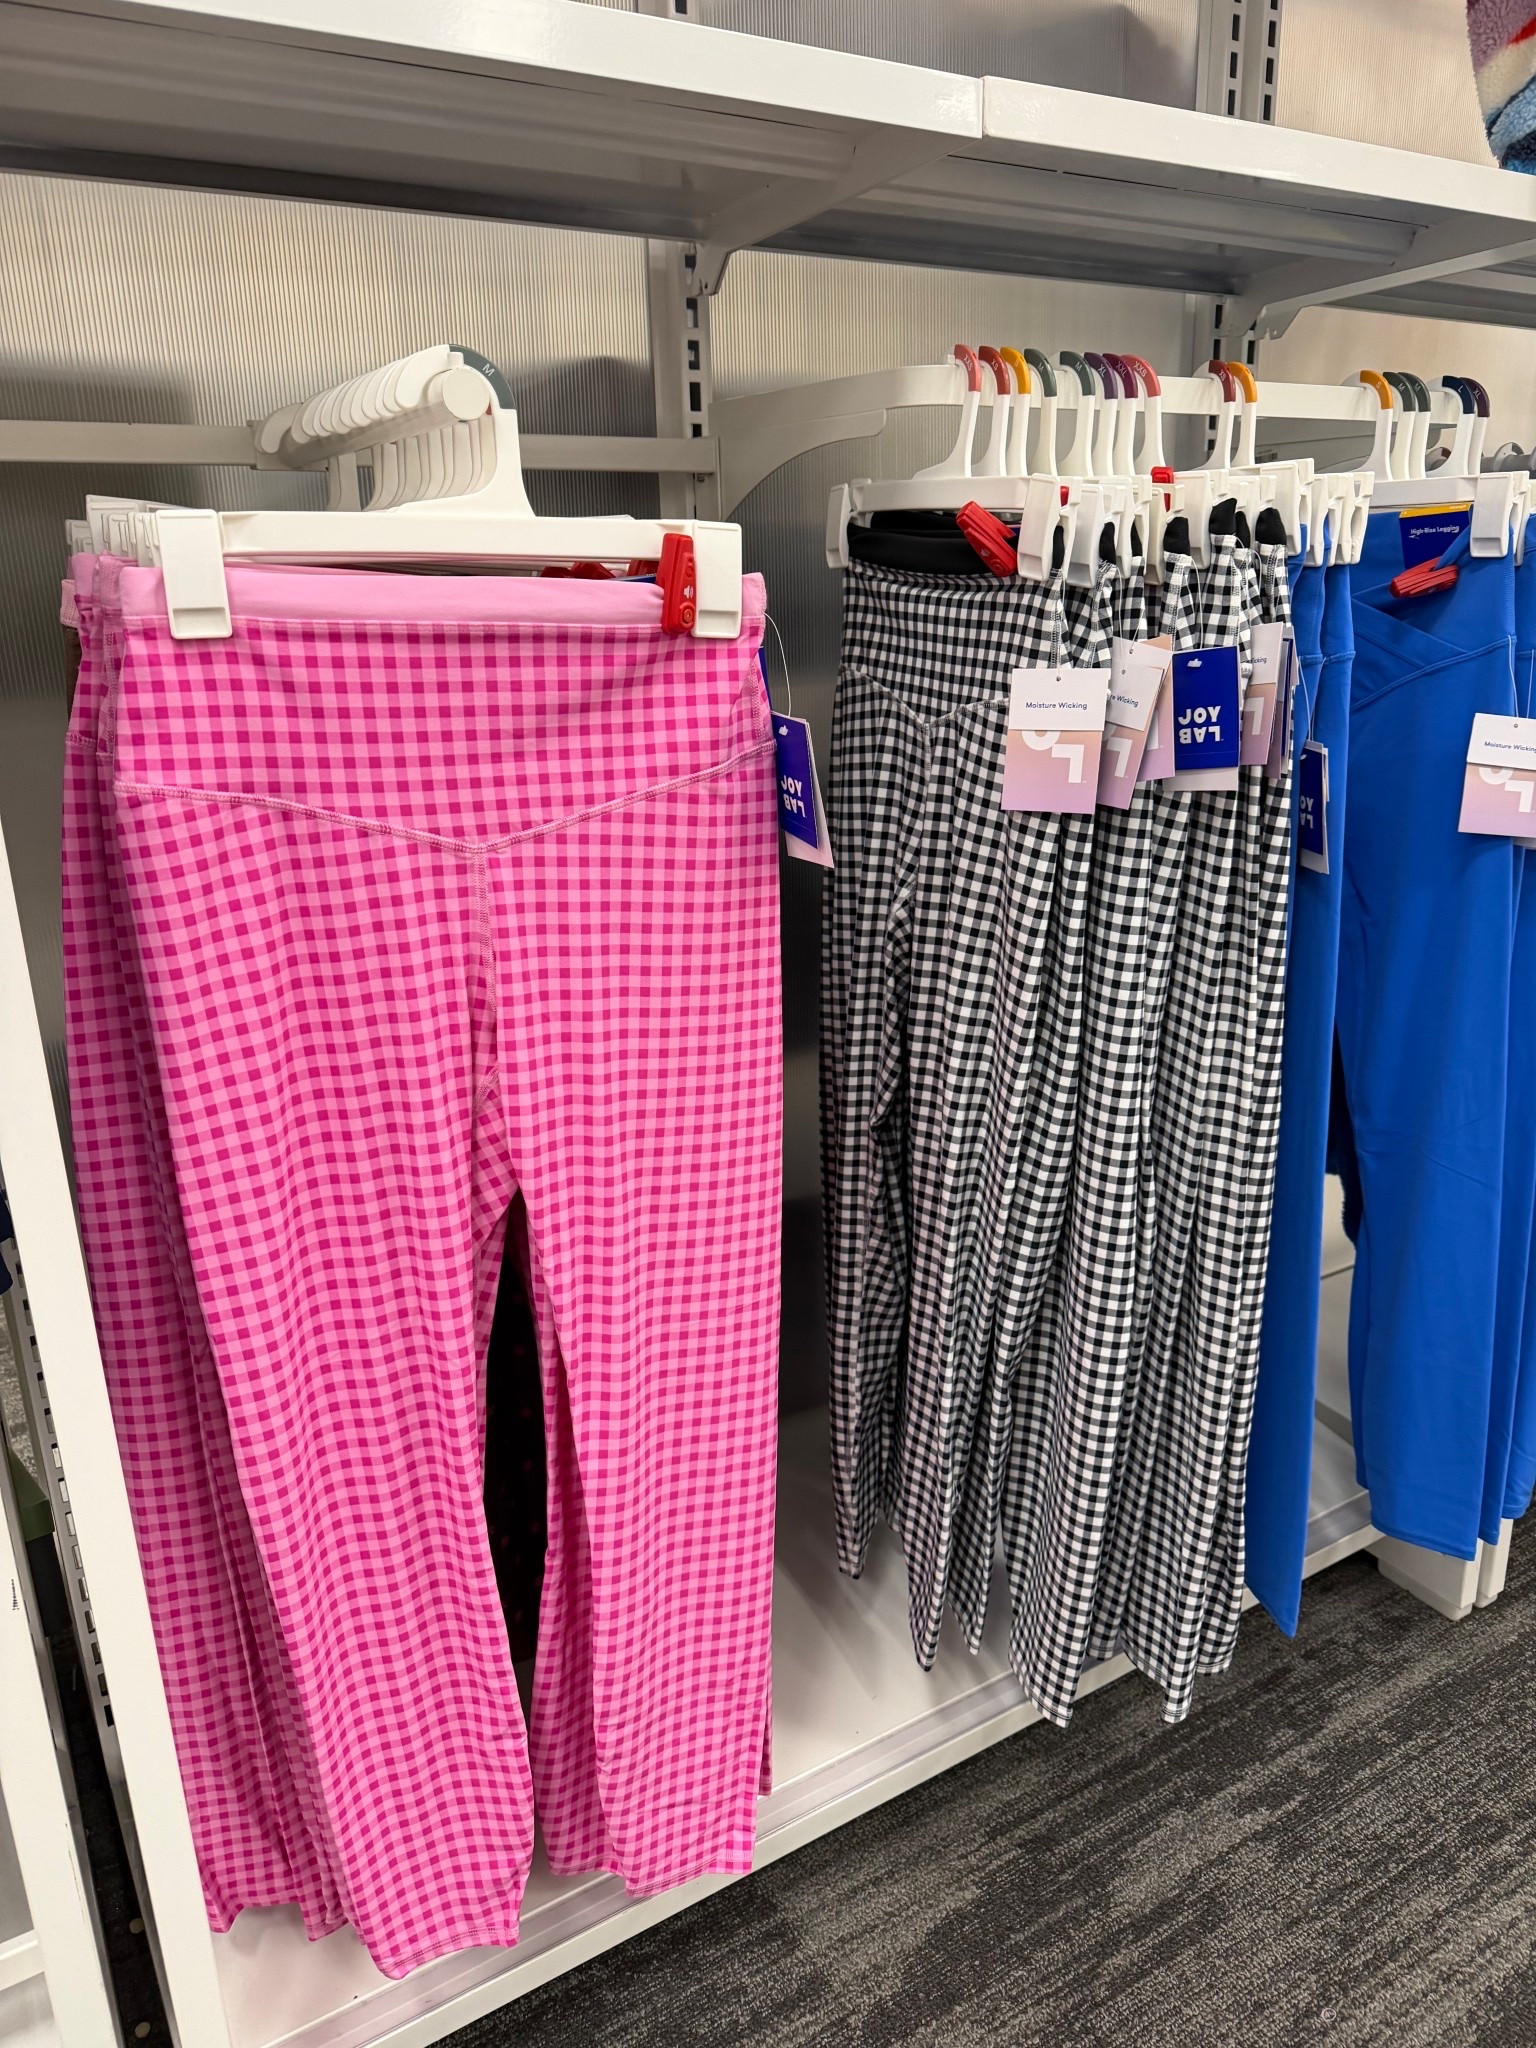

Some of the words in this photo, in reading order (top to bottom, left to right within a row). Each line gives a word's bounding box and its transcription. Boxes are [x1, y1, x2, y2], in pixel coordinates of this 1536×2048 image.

[963, 353, 974, 371] XXS
[991, 358, 999, 371] XS
[1075, 361, 1083, 372] M
[1115, 360, 1128, 377] XXL
[1133, 360, 1148, 378] XXS
[482, 363, 496, 377] M
[1098, 364, 1107, 378] XL
[1397, 383, 1406, 392] M
[1413, 382, 1421, 391] M
[1457, 385, 1464, 393] L
[1473, 388, 1482, 400] XL
[1058, 702, 1088, 711] Wicking
[1116, 694, 1139, 708] Wicking
[1177, 705, 1221, 726] JOY
[1178, 725, 1221, 745] LAB
[1484, 741, 1512, 750] Moisture
[1513, 744, 1536, 754] Wicking
[781, 775, 802, 797] JOY
[784, 795, 805, 818] LAB
[1300, 795, 1314, 812] OY
[1300, 811, 1314, 829] LA
